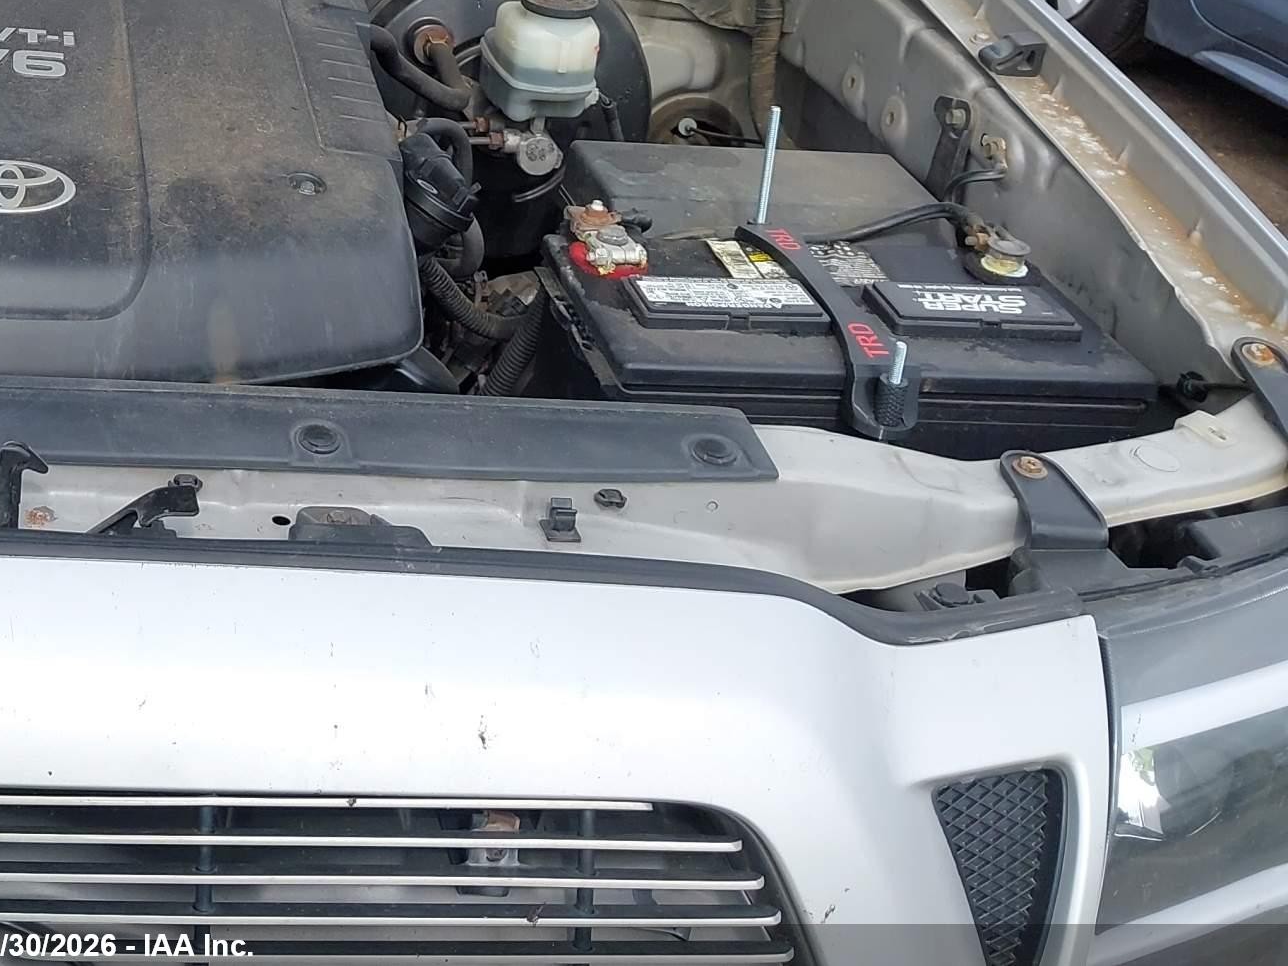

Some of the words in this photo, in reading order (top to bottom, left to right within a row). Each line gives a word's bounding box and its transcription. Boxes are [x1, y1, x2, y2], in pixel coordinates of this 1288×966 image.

[765, 228, 801, 250] TRD
[923, 301, 1023, 314] SUPER
[847, 322, 890, 358] TRD
